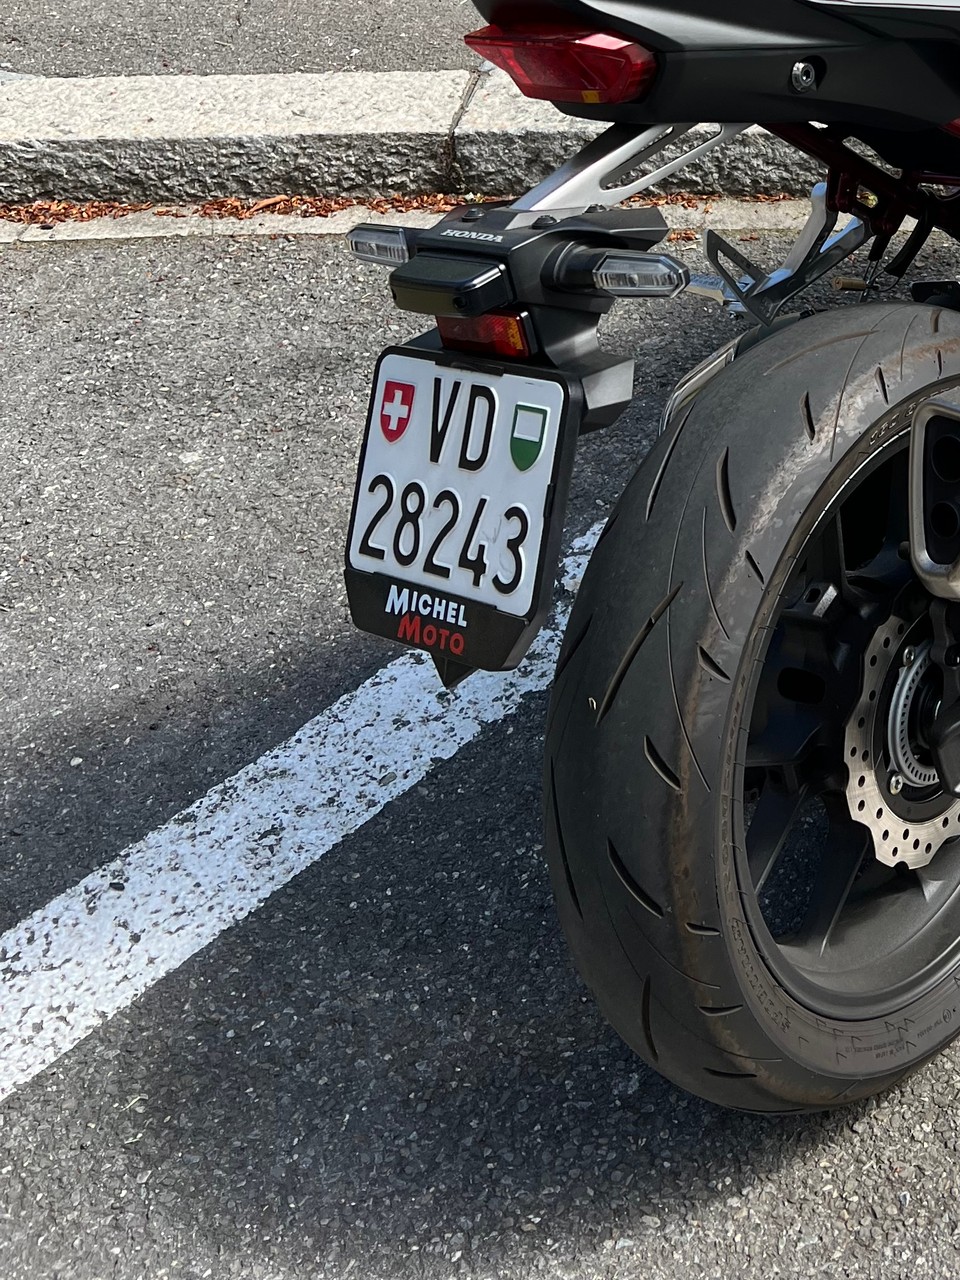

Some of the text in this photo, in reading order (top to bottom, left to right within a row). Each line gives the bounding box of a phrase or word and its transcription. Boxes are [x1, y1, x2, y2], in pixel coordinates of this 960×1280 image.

[440, 229, 504, 243] HONDA
[429, 376, 497, 472] VD
[358, 474, 529, 595] 28243
[385, 584, 468, 628] MICHEL
[397, 613, 465, 656] MOTO
